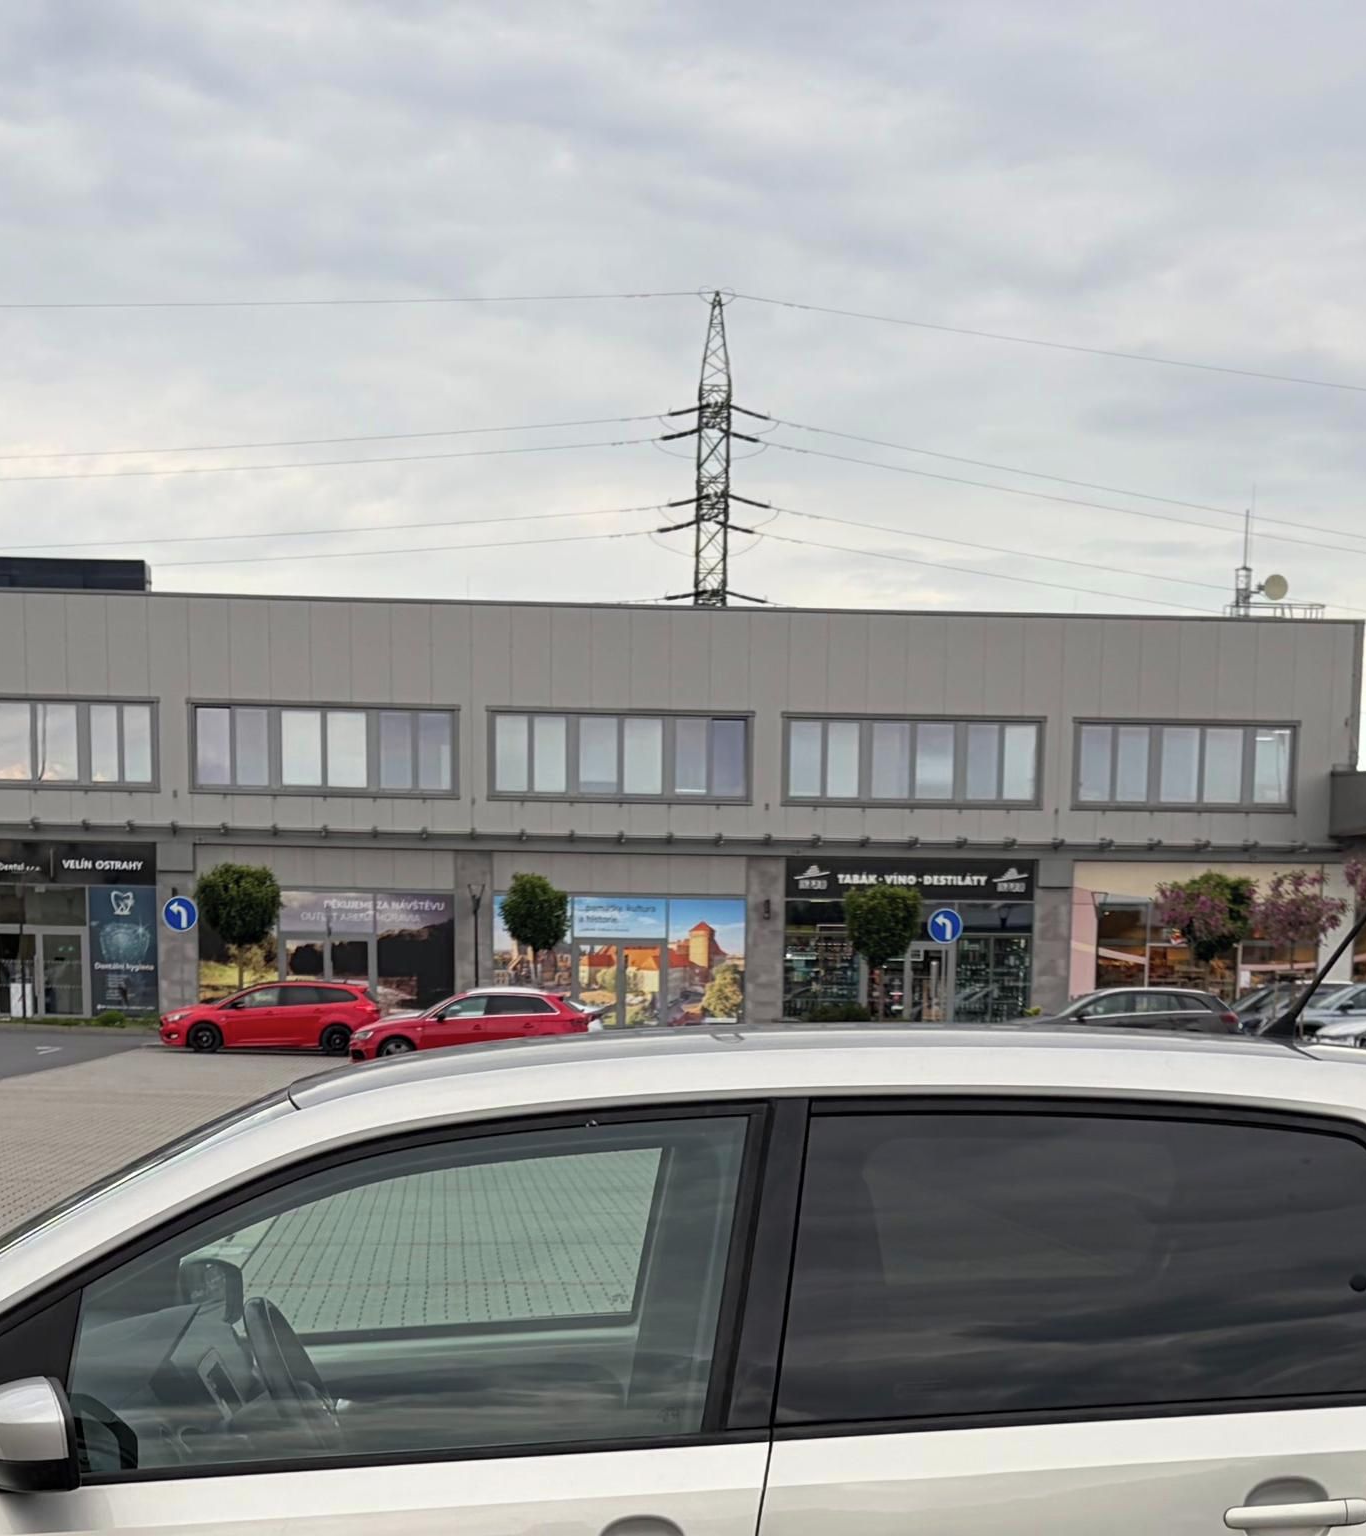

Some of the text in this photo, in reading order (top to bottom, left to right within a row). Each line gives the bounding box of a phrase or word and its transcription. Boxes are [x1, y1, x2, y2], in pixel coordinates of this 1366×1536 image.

[62, 857, 144, 871] VELÍN OSTRAHY
[837, 871, 988, 886] TABÁK VÍNO DESTILÁTY
[300, 911, 338, 921] OUTLT
